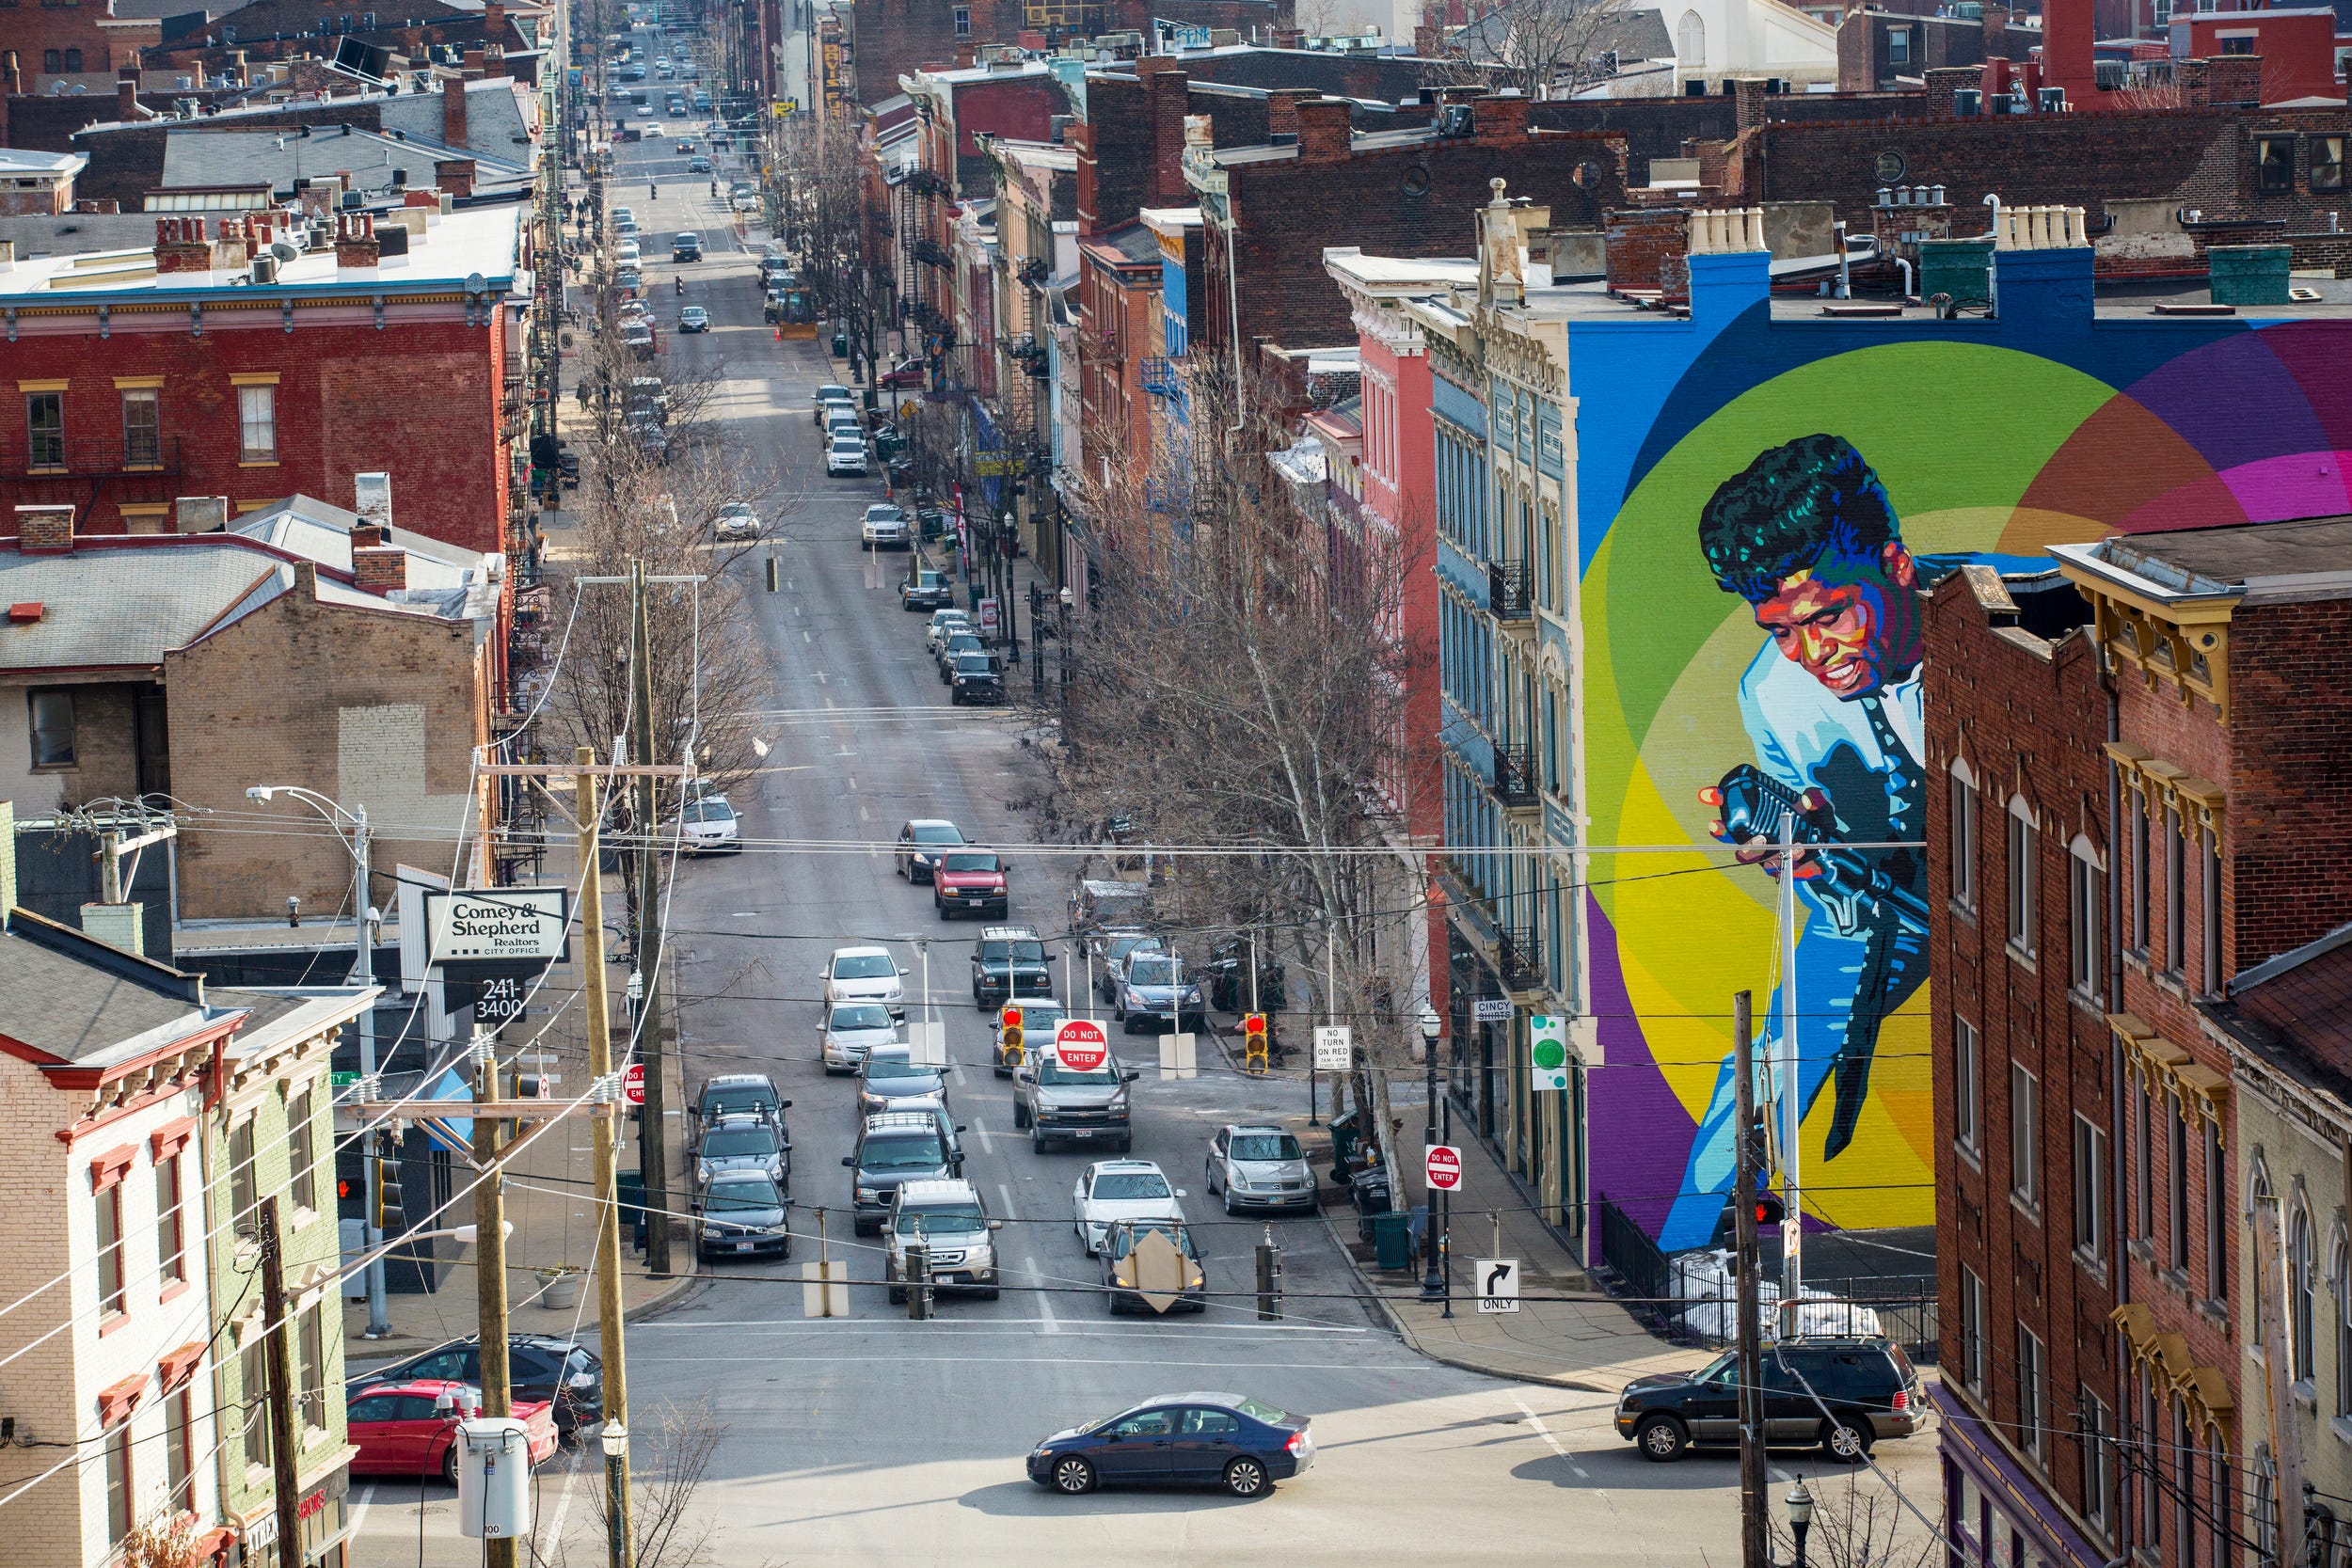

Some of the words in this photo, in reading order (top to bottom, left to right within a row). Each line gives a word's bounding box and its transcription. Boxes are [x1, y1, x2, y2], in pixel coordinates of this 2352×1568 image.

[824, 44, 840, 87] DAVIS
[453, 904, 517, 921] Comey
[520, 903, 537, 918] &
[452, 920, 540, 938] Shepherd
[494, 938, 539, 946] Realtors
[477, 999, 523, 1018] 3400
[1478, 1002, 1511, 1011] CINCY
[1478, 1011, 1511, 1021] SHIRTS
[1063, 1030, 1076, 1038] DO
[1080, 1031, 1099, 1039] NOT
[1067, 1053, 1097, 1063] ENTER
[631, 1089, 644, 1098] ENT
[1431, 1153, 1440, 1162] DO
[1433, 1172, 1454, 1181] ENTER
[1484, 1297, 1513, 1309] ONLY
